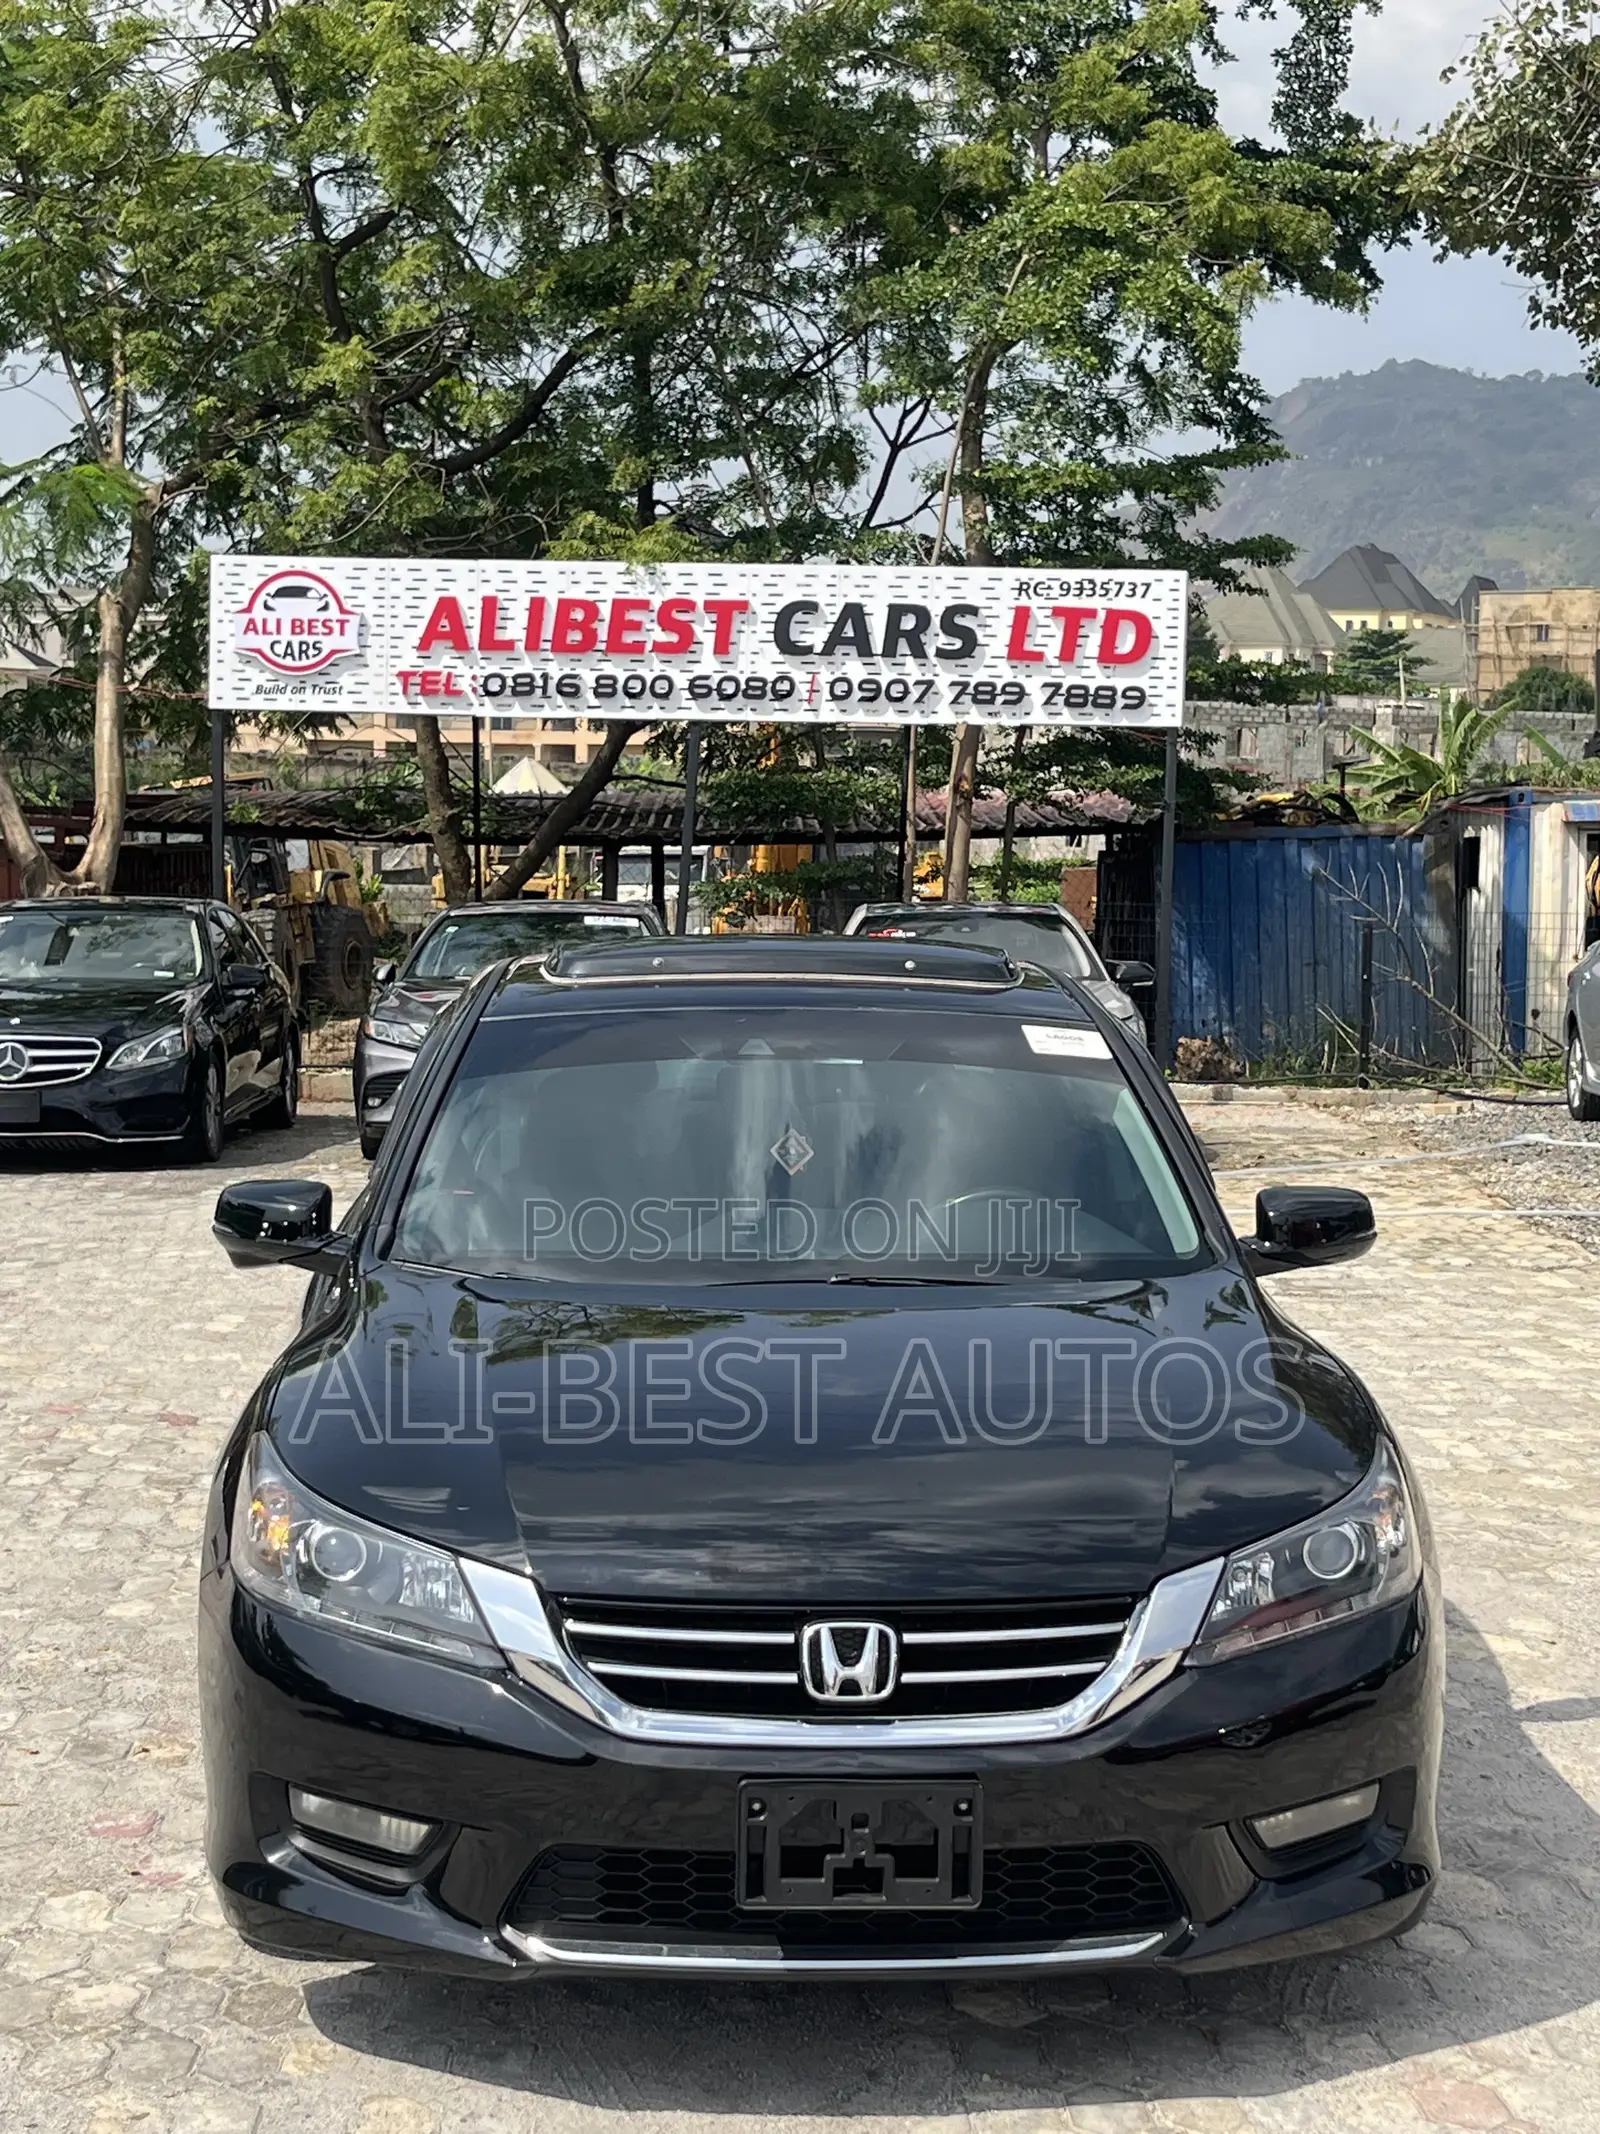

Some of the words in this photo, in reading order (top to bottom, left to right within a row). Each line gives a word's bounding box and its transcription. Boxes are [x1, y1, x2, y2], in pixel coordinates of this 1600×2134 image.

[1058, 581, 1151, 599] 9335737
[243, 618, 282, 636] ALI
[290, 618, 350, 636] BEST
[416, 595, 749, 655] ALIBEST
[773, 600, 979, 660] CARS
[1007, 606, 1153, 665] LTD
[270, 640, 323, 661] CARS
[255, 684, 288, 695] Build
[290, 687, 307, 695] on
[311, 684, 344, 695] Trust
[481, 672, 581, 699] 0816
[593, 674, 675, 700] 800
[688, 674, 796, 703] 6080
[829, 676, 935, 705] 0907
[948, 680, 1027, 706] 789
[1040, 682, 1147, 710] 7889
